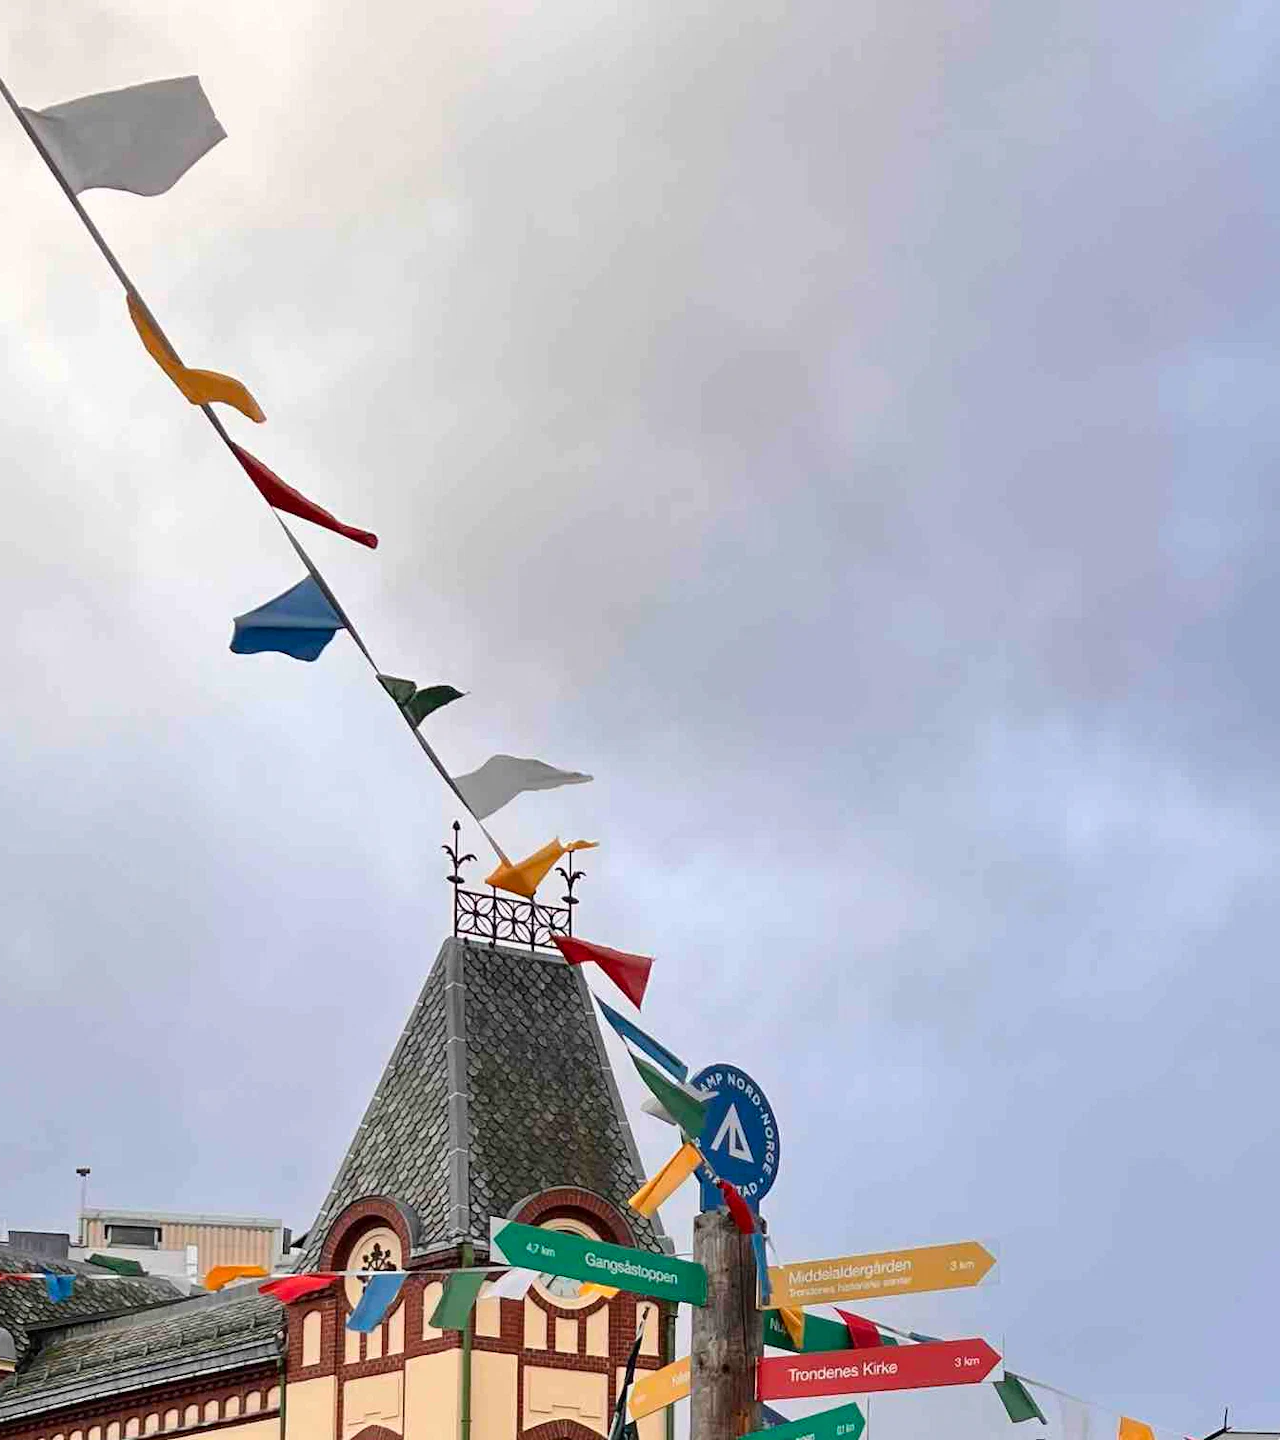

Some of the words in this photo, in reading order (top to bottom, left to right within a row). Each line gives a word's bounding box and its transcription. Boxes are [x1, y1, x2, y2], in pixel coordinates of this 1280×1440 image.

[541, 1246, 556, 1257] km
[584, 1252, 678, 1285] Gangsåstoppen
[959, 1260, 975, 1270] km
[788, 1363, 859, 1382] Trondenes
[862, 1361, 898, 1376] Kirke
[954, 1356, 962, 1368] 3
[964, 1356, 980, 1366] km
